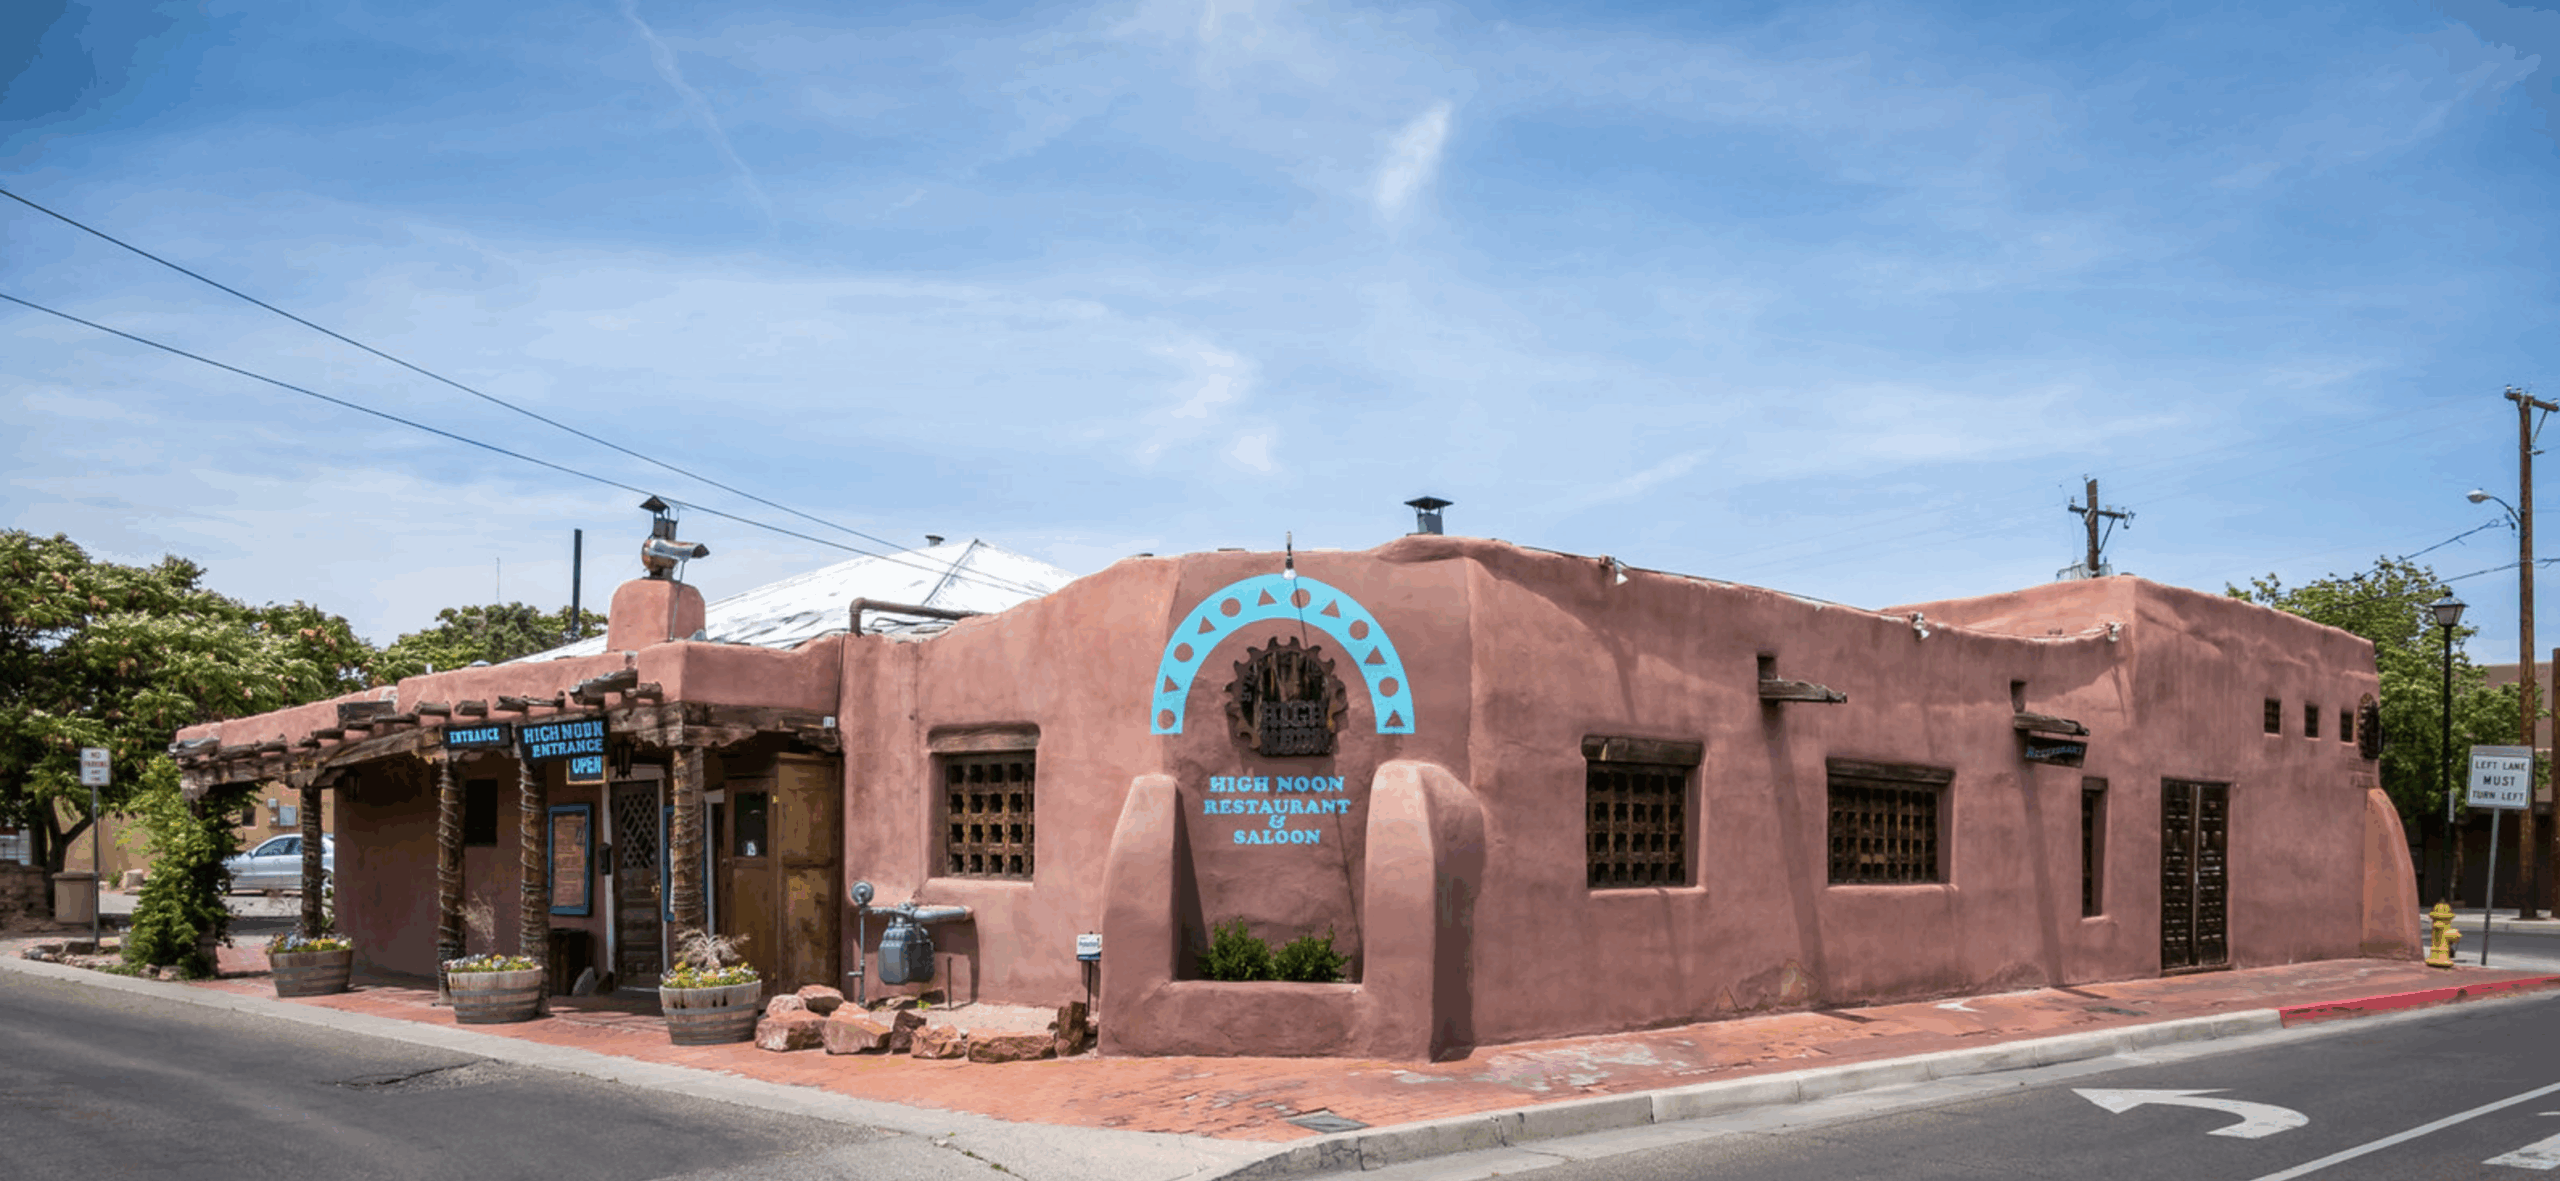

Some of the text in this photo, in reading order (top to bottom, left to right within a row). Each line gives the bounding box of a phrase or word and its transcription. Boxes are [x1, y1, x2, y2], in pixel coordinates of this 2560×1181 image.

[450, 728, 499, 744] ENTRANCE
[523, 720, 604, 744] HIGH NOON
[532, 738, 604, 758] ENTRANCE
[572, 755, 602, 774] OPEN
[2475, 761, 2526, 771] LEFT LANE
[1209, 775, 1345, 793] HIGH NOON
[2482, 775, 2515, 786] MUST
[2473, 790, 2524, 801] TURN LEFT
[1203, 799, 1352, 815] RESTAURANT
[1268, 814, 1287, 829] &
[1233, 829, 1321, 845] SALOON
